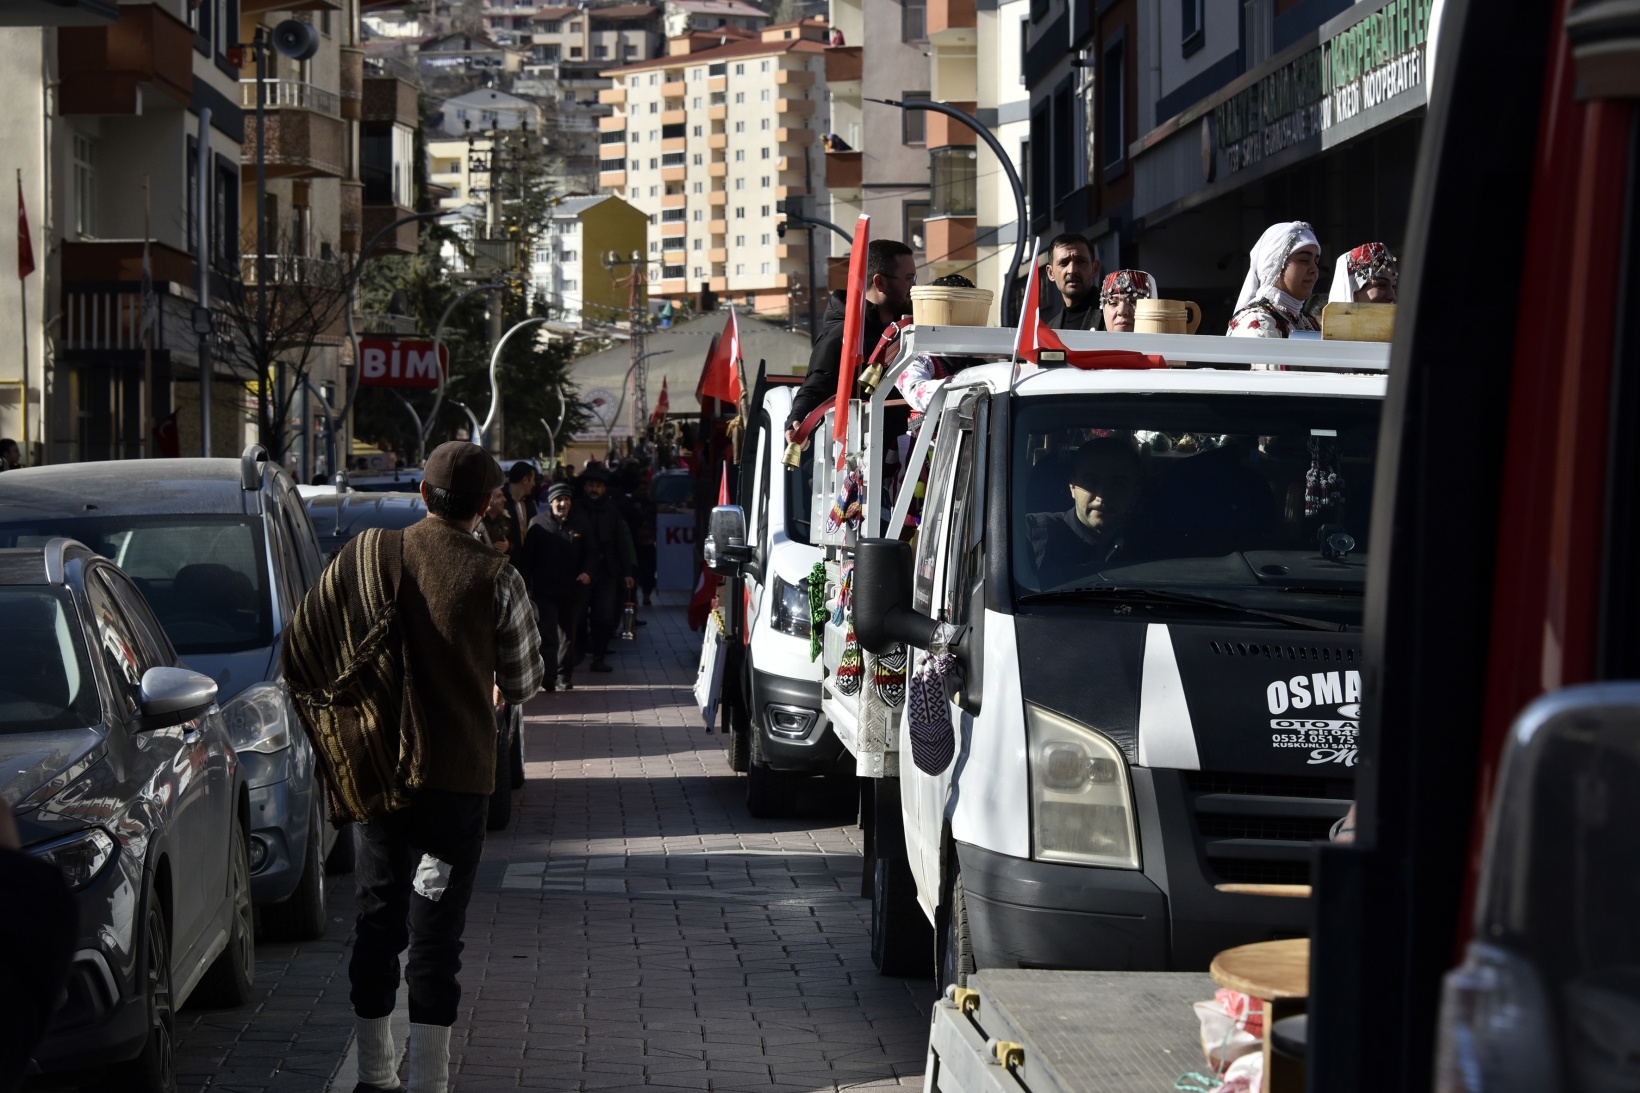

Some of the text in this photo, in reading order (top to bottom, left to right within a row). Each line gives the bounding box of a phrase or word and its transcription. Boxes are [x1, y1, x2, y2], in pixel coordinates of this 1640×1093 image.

[1336, 80, 1360, 124] KREDİ
[363, 341, 437, 380] BİM
[1275, 720, 1330, 728] OTO
[1272, 734, 1355, 744] 0532 051 75
